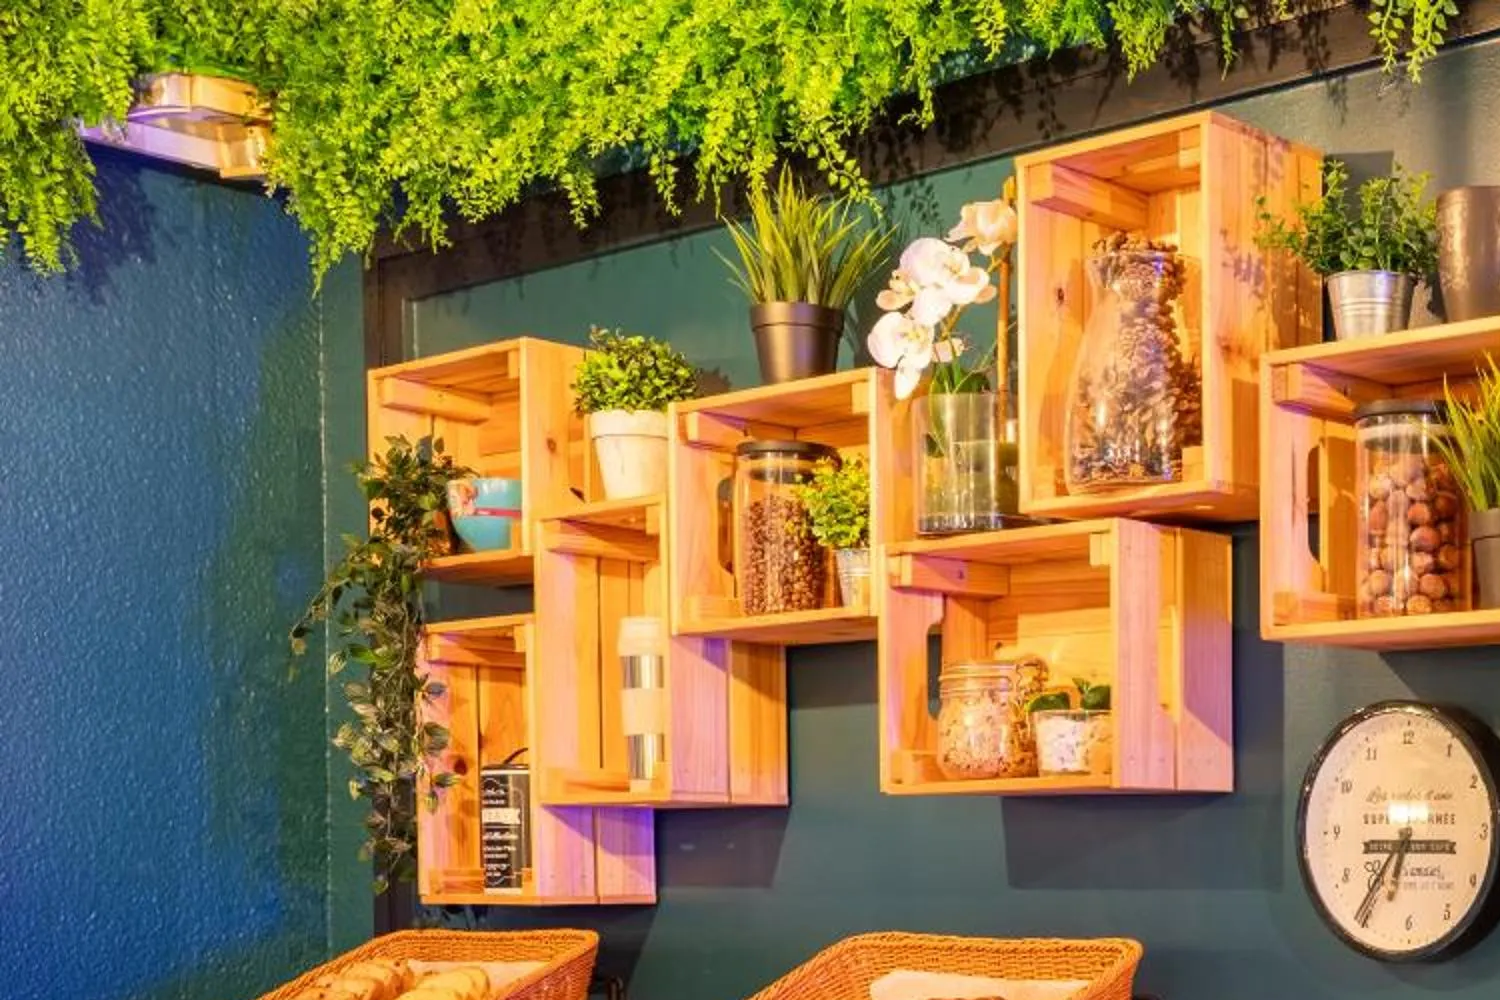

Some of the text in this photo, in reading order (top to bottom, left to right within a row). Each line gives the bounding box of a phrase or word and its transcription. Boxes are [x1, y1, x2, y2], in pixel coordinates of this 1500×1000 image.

[1403, 732, 1415, 745] 12
[1366, 748, 1378, 760] 11
[1341, 780, 1353, 793] 10
[1469, 775, 1478, 789] 2
[1333, 826, 1341, 839] 9
[1480, 824, 1489, 840] 3
[1342, 868, 1350, 882] 8
[1443, 903, 1452, 920] 5
[1405, 915, 1413, 930] 6
